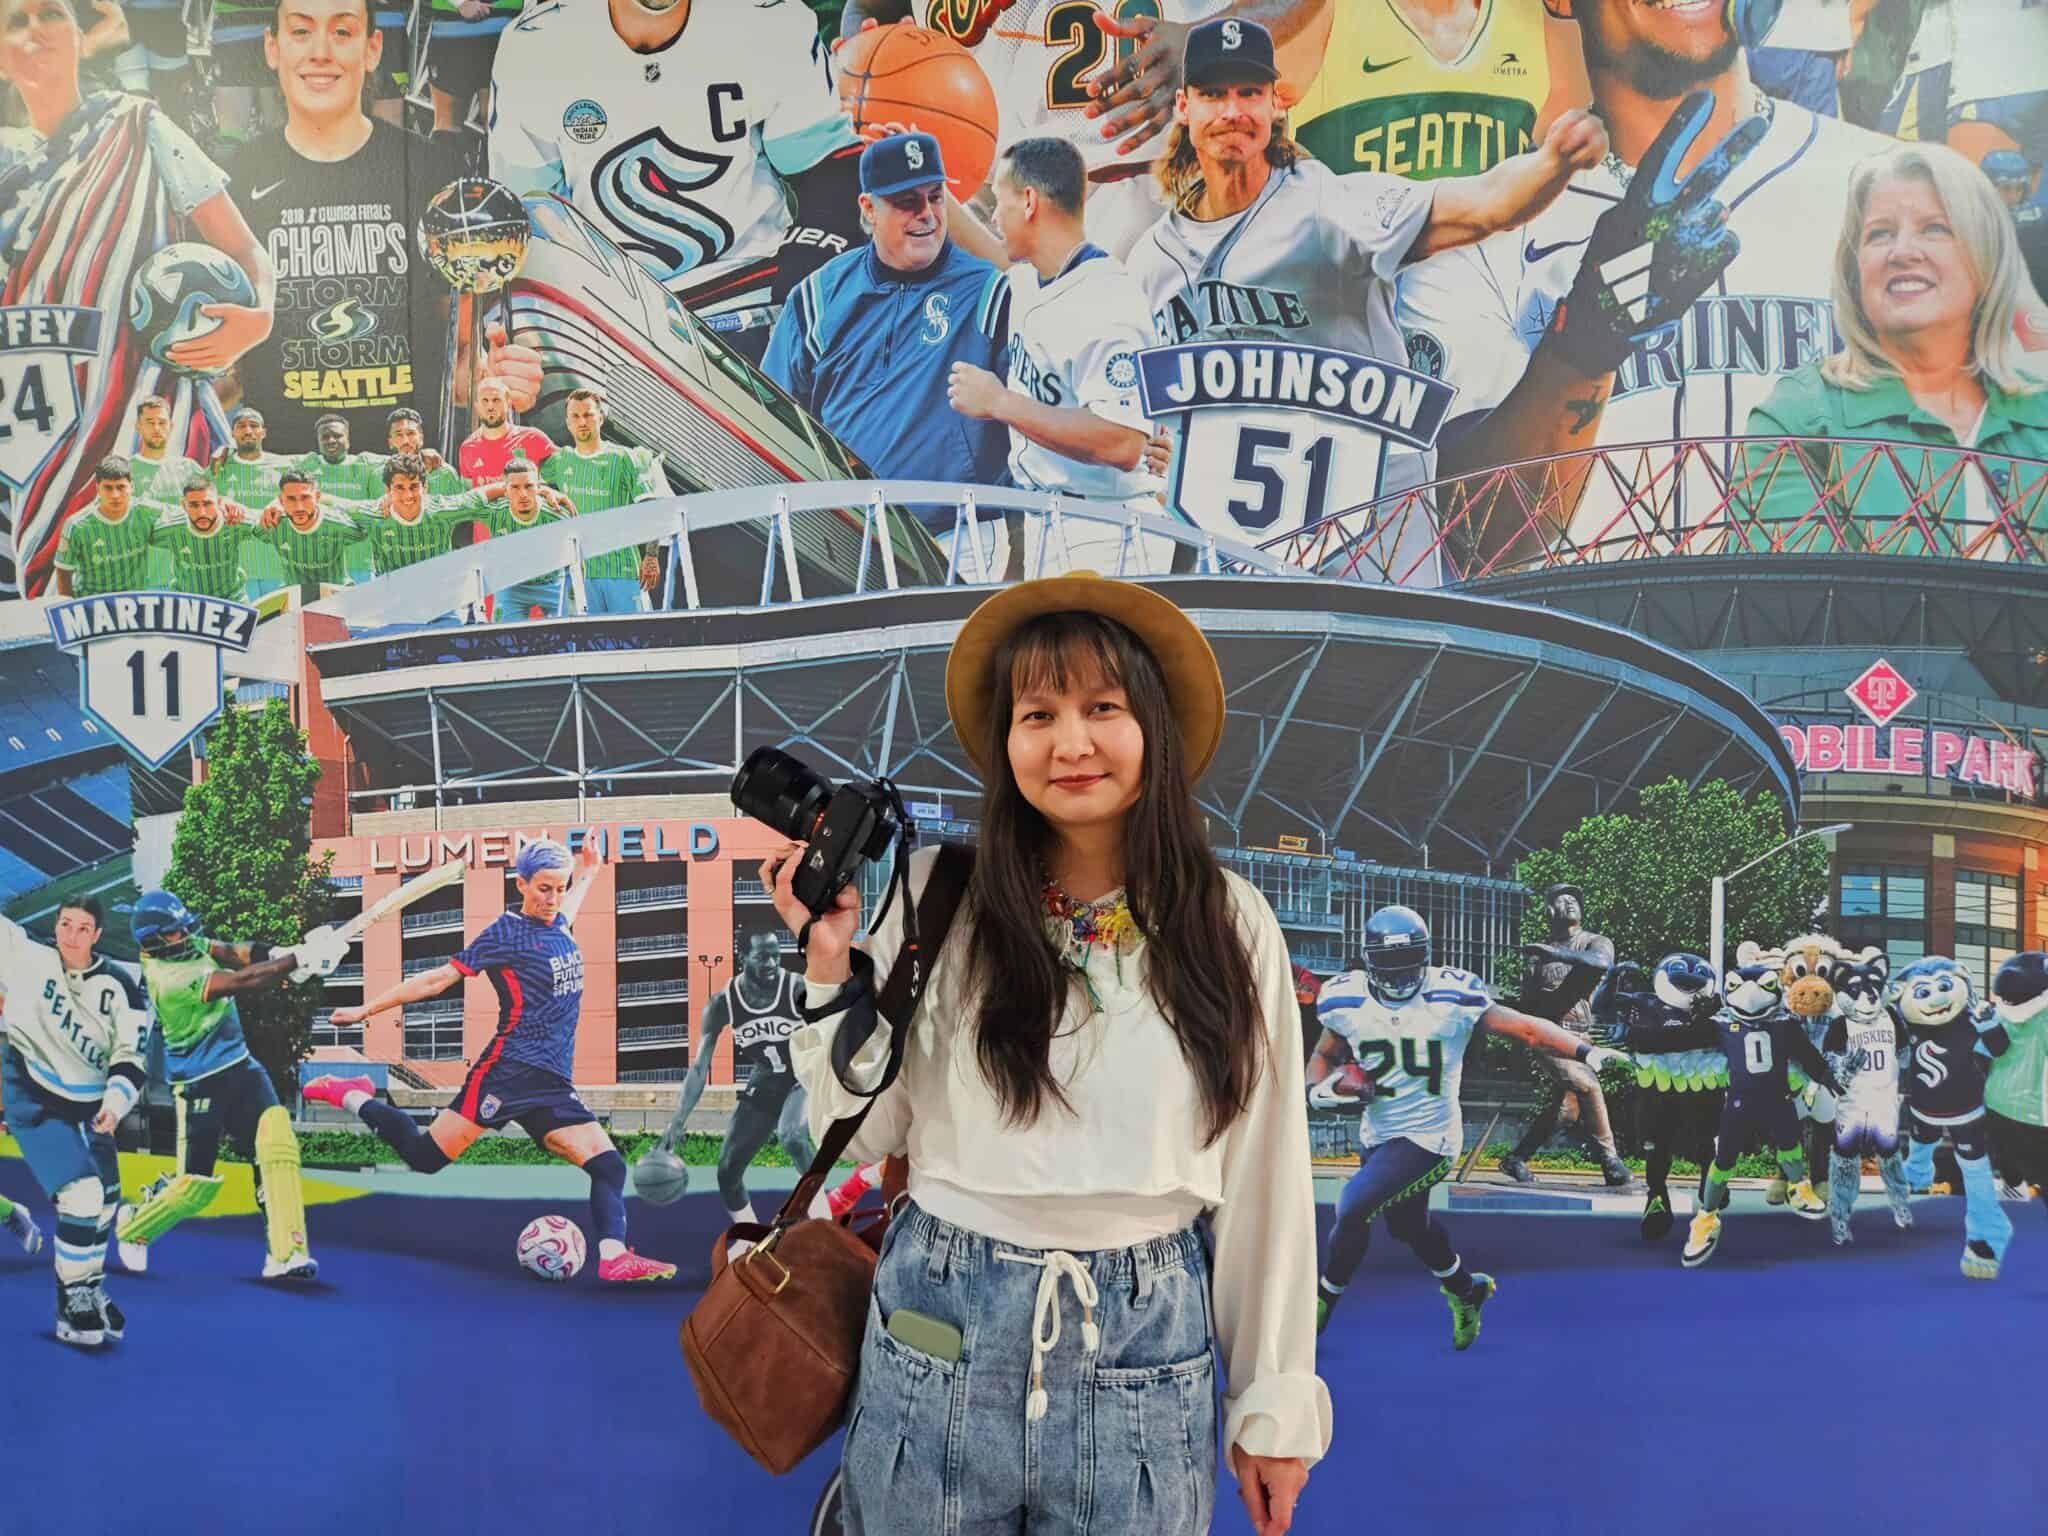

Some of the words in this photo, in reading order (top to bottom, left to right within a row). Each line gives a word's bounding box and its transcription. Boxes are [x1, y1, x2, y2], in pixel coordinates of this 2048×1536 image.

[707, 83, 746, 142] C
[0, 309, 77, 346] FEY
[281, 336, 411, 370] STORM
[1608, 297, 1845, 402] RINE
[284, 364, 414, 400] SEATTLE
[1166, 349, 1428, 430] JOHNSON
[1227, 427, 1335, 530] 51
[60, 596, 250, 643] MARTINEZ
[126, 650, 180, 717] 11
[1930, 730, 2036, 800] PARK
[565, 823, 720, 866] FIELD
[43, 978, 104, 1071] SEATTLE
[100, 988, 115, 1016] C
[763, 1046, 787, 1073] 1
[1359, 1038, 1442, 1098] 24
[1744, 1030, 1774, 1074] 0
